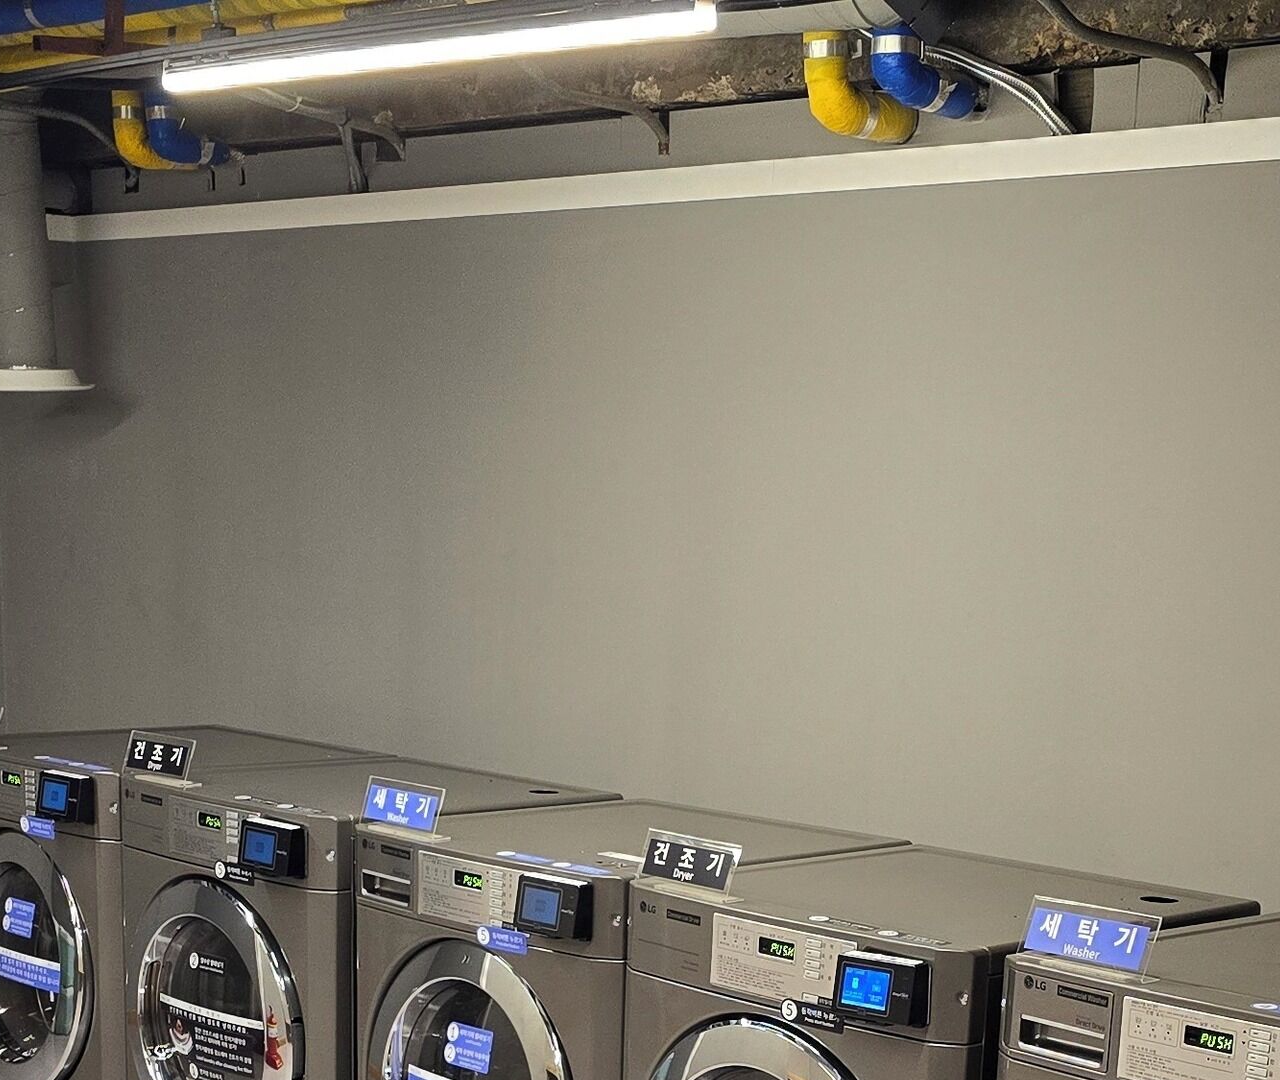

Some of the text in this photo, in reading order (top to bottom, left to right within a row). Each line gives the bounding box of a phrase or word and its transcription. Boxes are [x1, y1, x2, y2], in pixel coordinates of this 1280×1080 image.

[134, 741, 184, 767] 건조기
[373, 788, 431, 818] 세탁기
[654, 842, 725, 877] 건조기
[673, 868, 694, 881] Dryer
[648, 904, 656, 913] LG
[1040, 913, 1138, 954] 세탁기
[770, 941, 795, 959] PUSH
[1063, 943, 1100, 960] Washer
[1035, 980, 1046, 991] LG
[1200, 1033, 1233, 1050] PUSH
